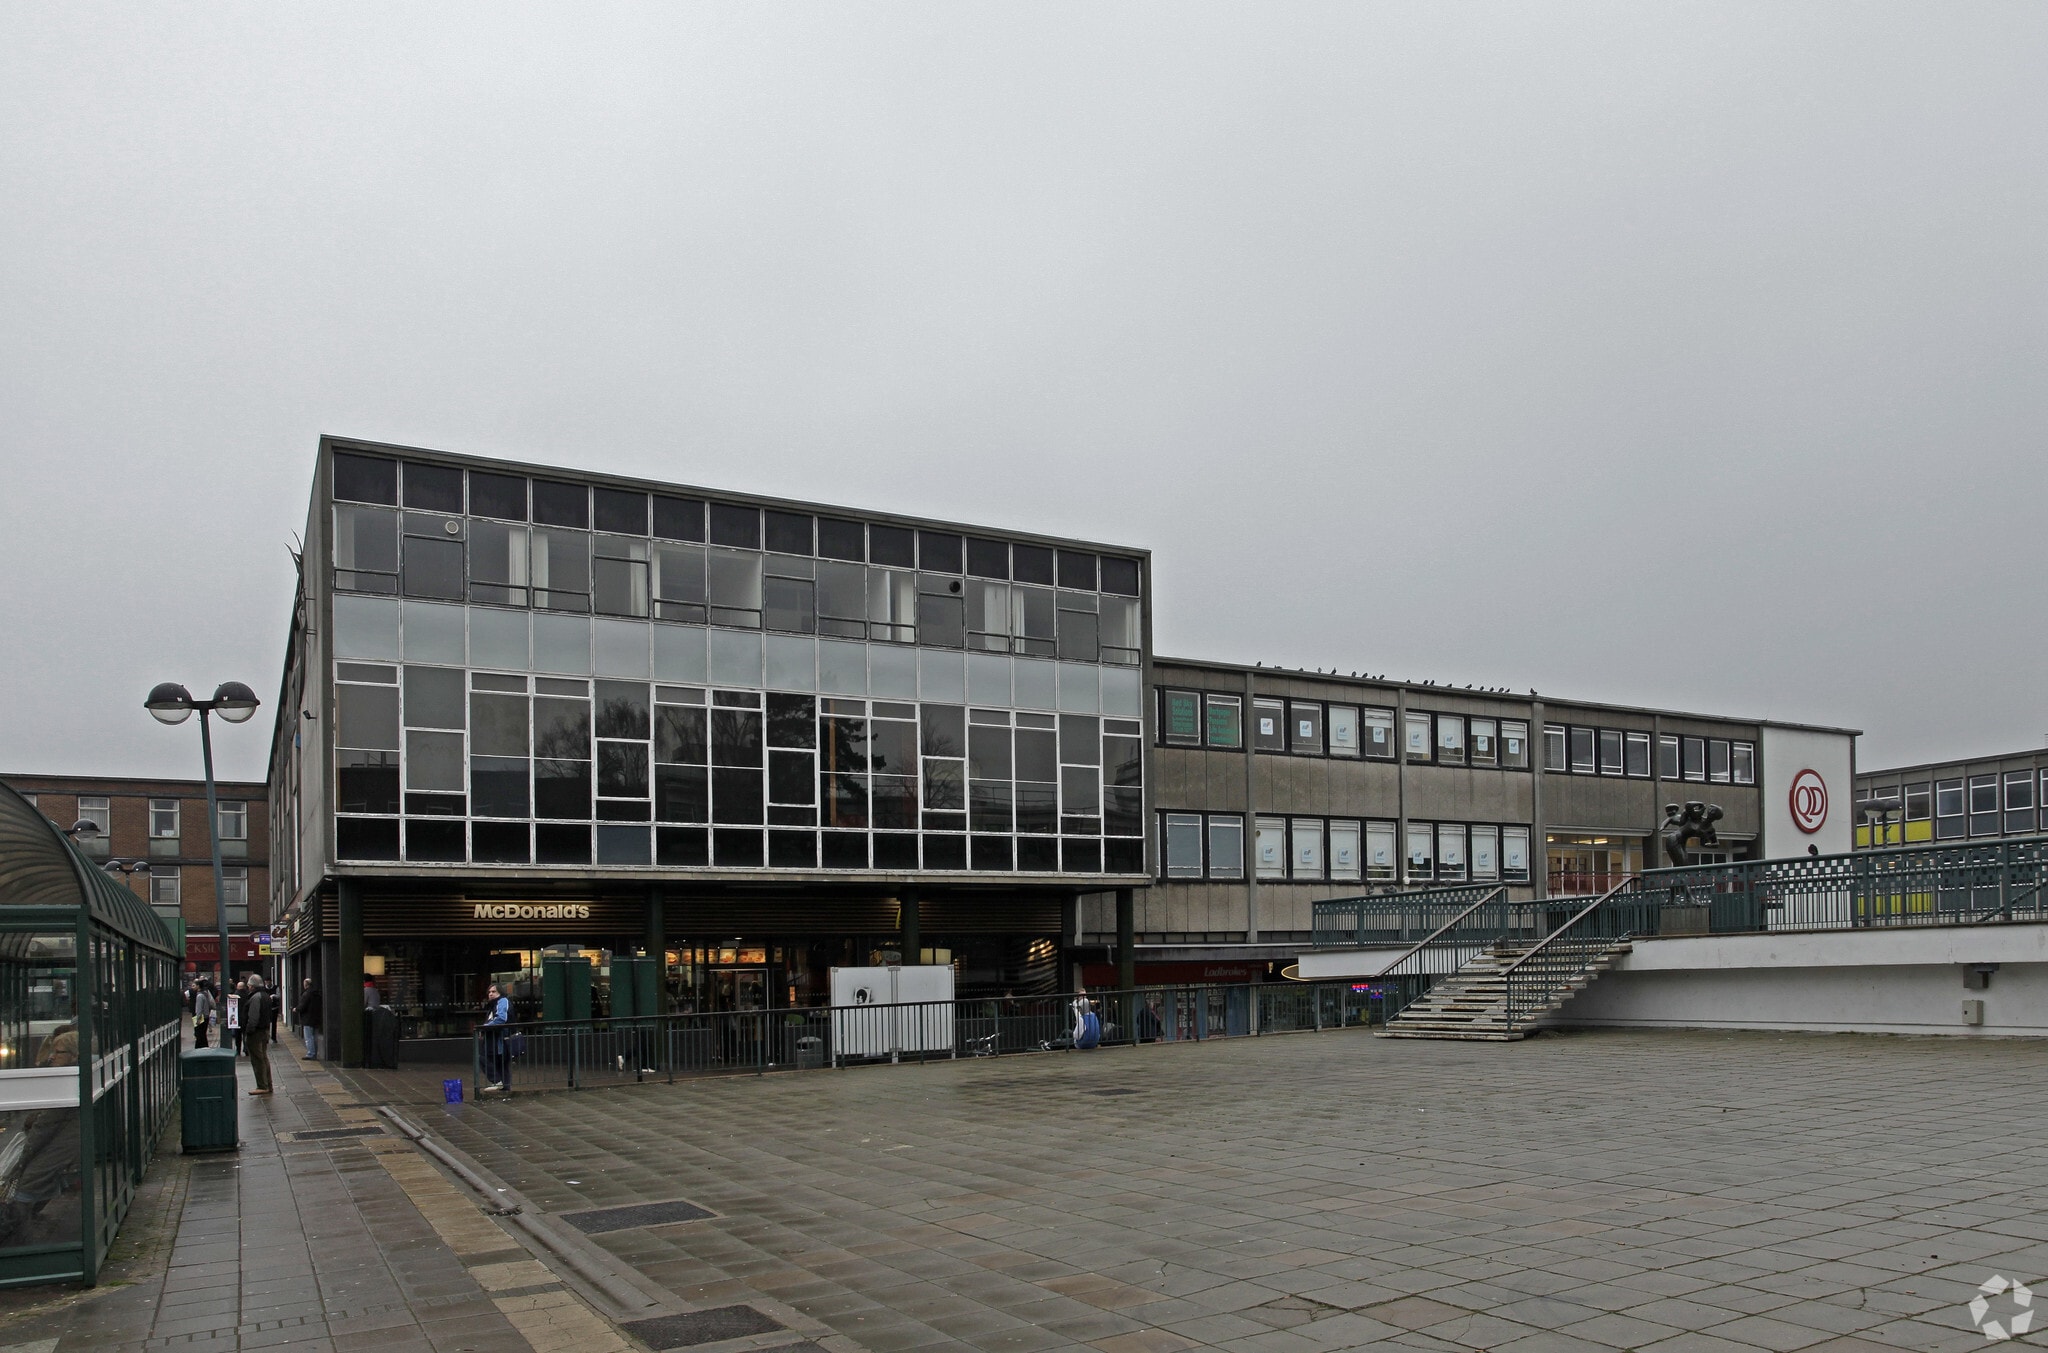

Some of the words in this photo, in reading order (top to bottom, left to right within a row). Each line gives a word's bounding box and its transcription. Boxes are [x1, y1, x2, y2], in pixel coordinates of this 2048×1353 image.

[1795, 786, 1825, 823] QD
[473, 904, 590, 919] McDonald's
[185, 943, 238, 953] CKSILR
[1204, 966, 1248, 977] Ladbrokes
